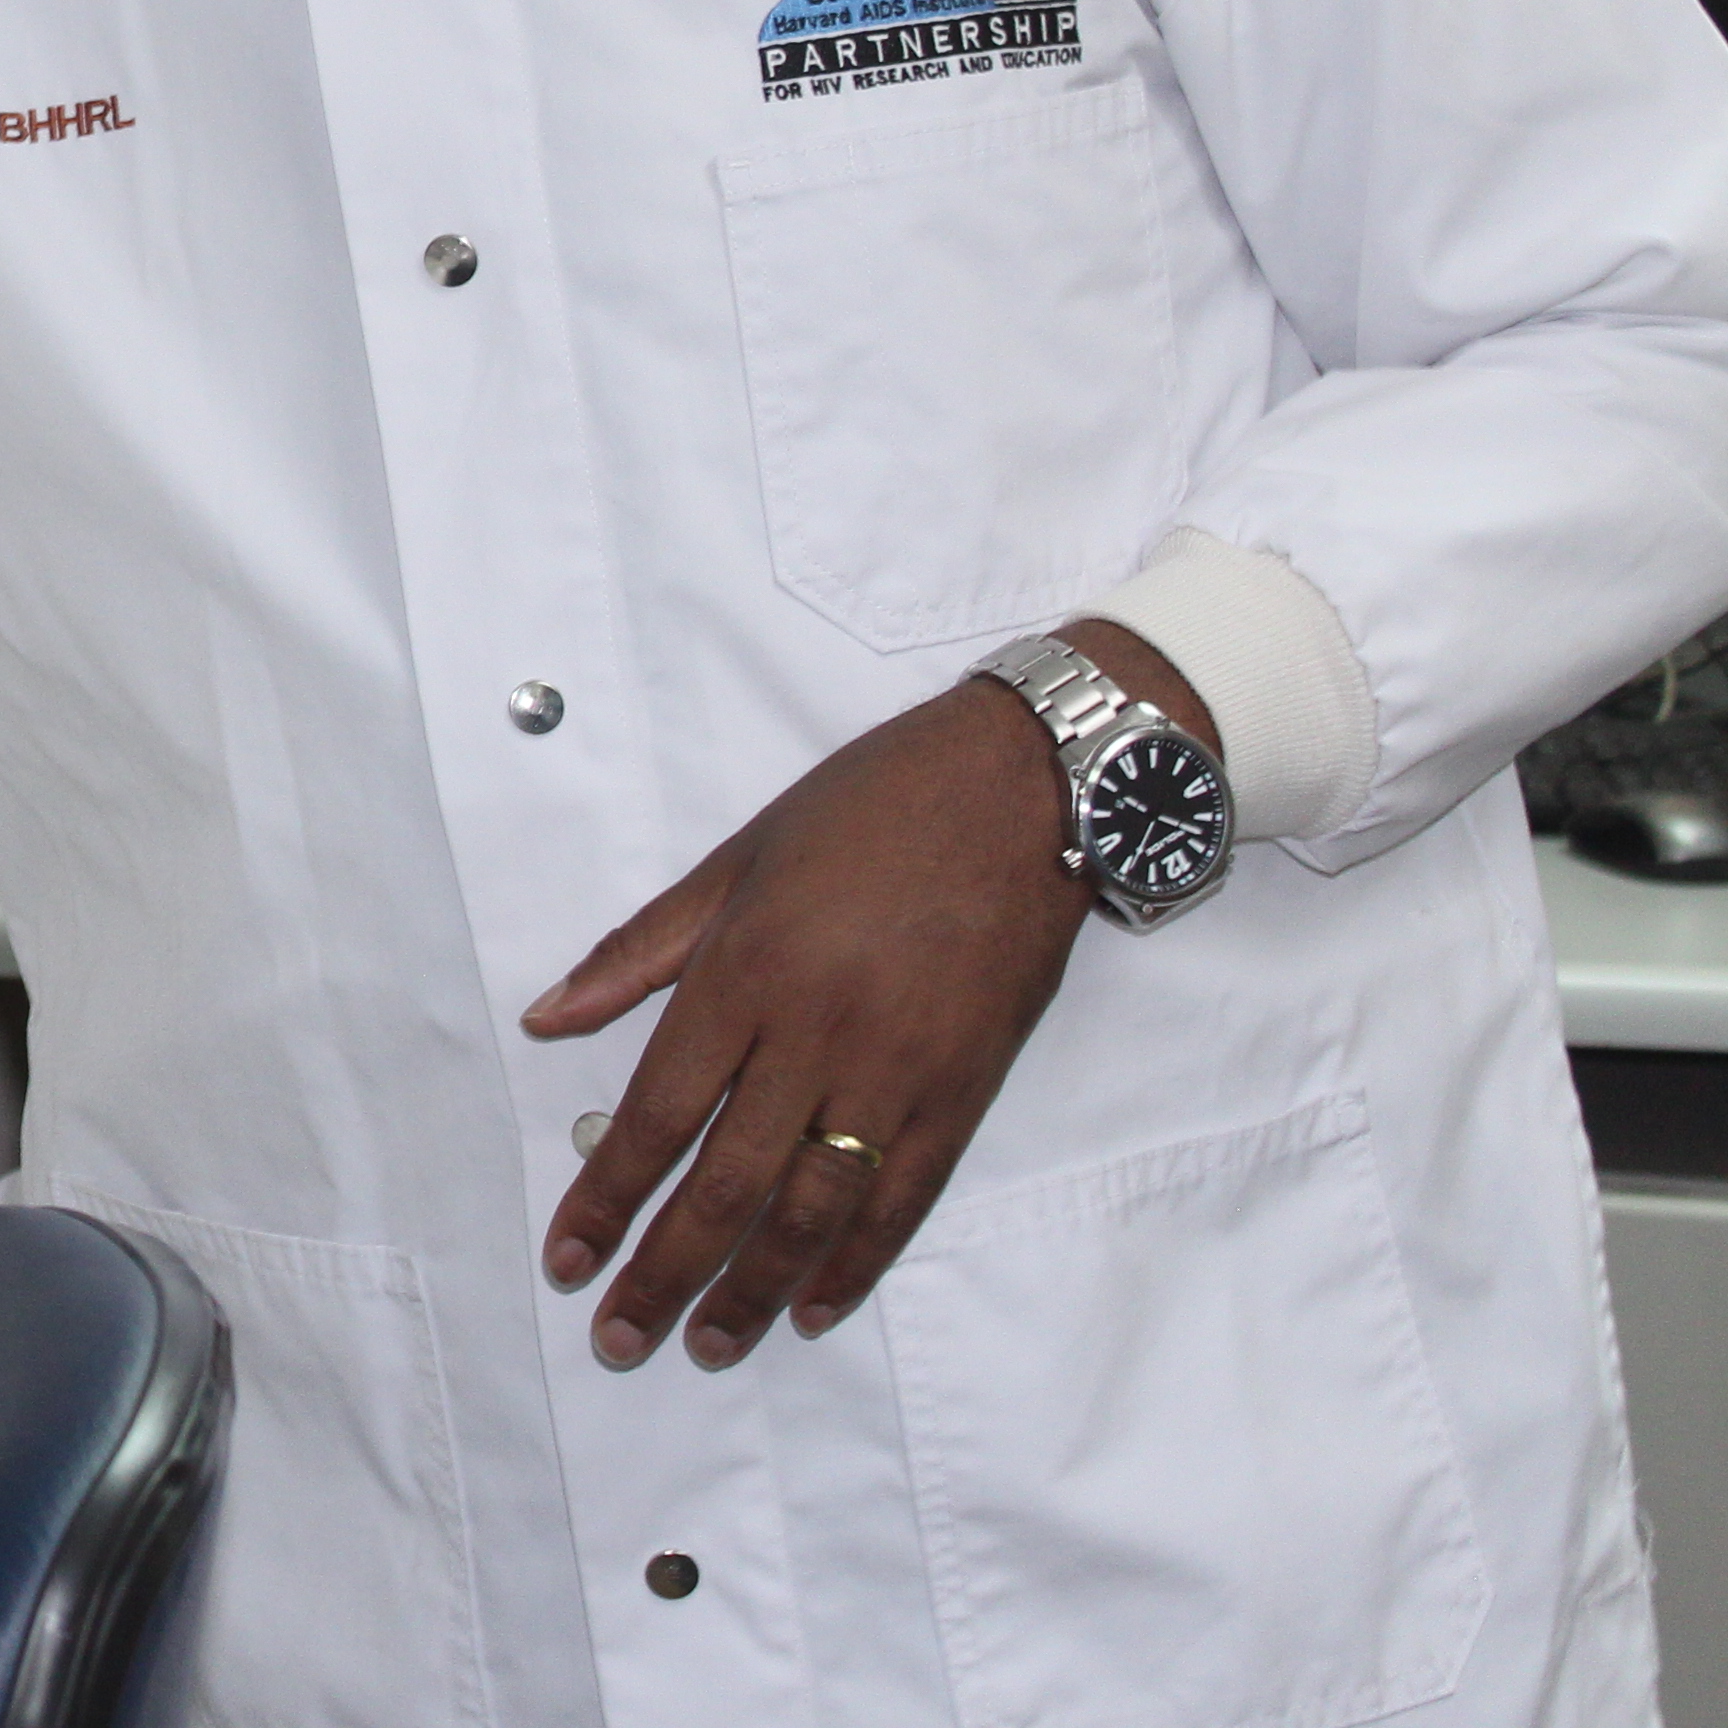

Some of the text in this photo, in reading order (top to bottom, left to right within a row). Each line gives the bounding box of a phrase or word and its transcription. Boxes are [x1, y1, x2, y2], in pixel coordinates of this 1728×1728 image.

[773, 7, 852, 35] Harvard
[765, 11, 1079, 78] PARTNERSHIP
[763, 84, 802, 103] FOR
[812, 76, 844, 96] HIV
[853, 61, 950, 90] RESEARCH
[959, 55, 993, 74] AND
[1159, 848, 1193, 880] 12
